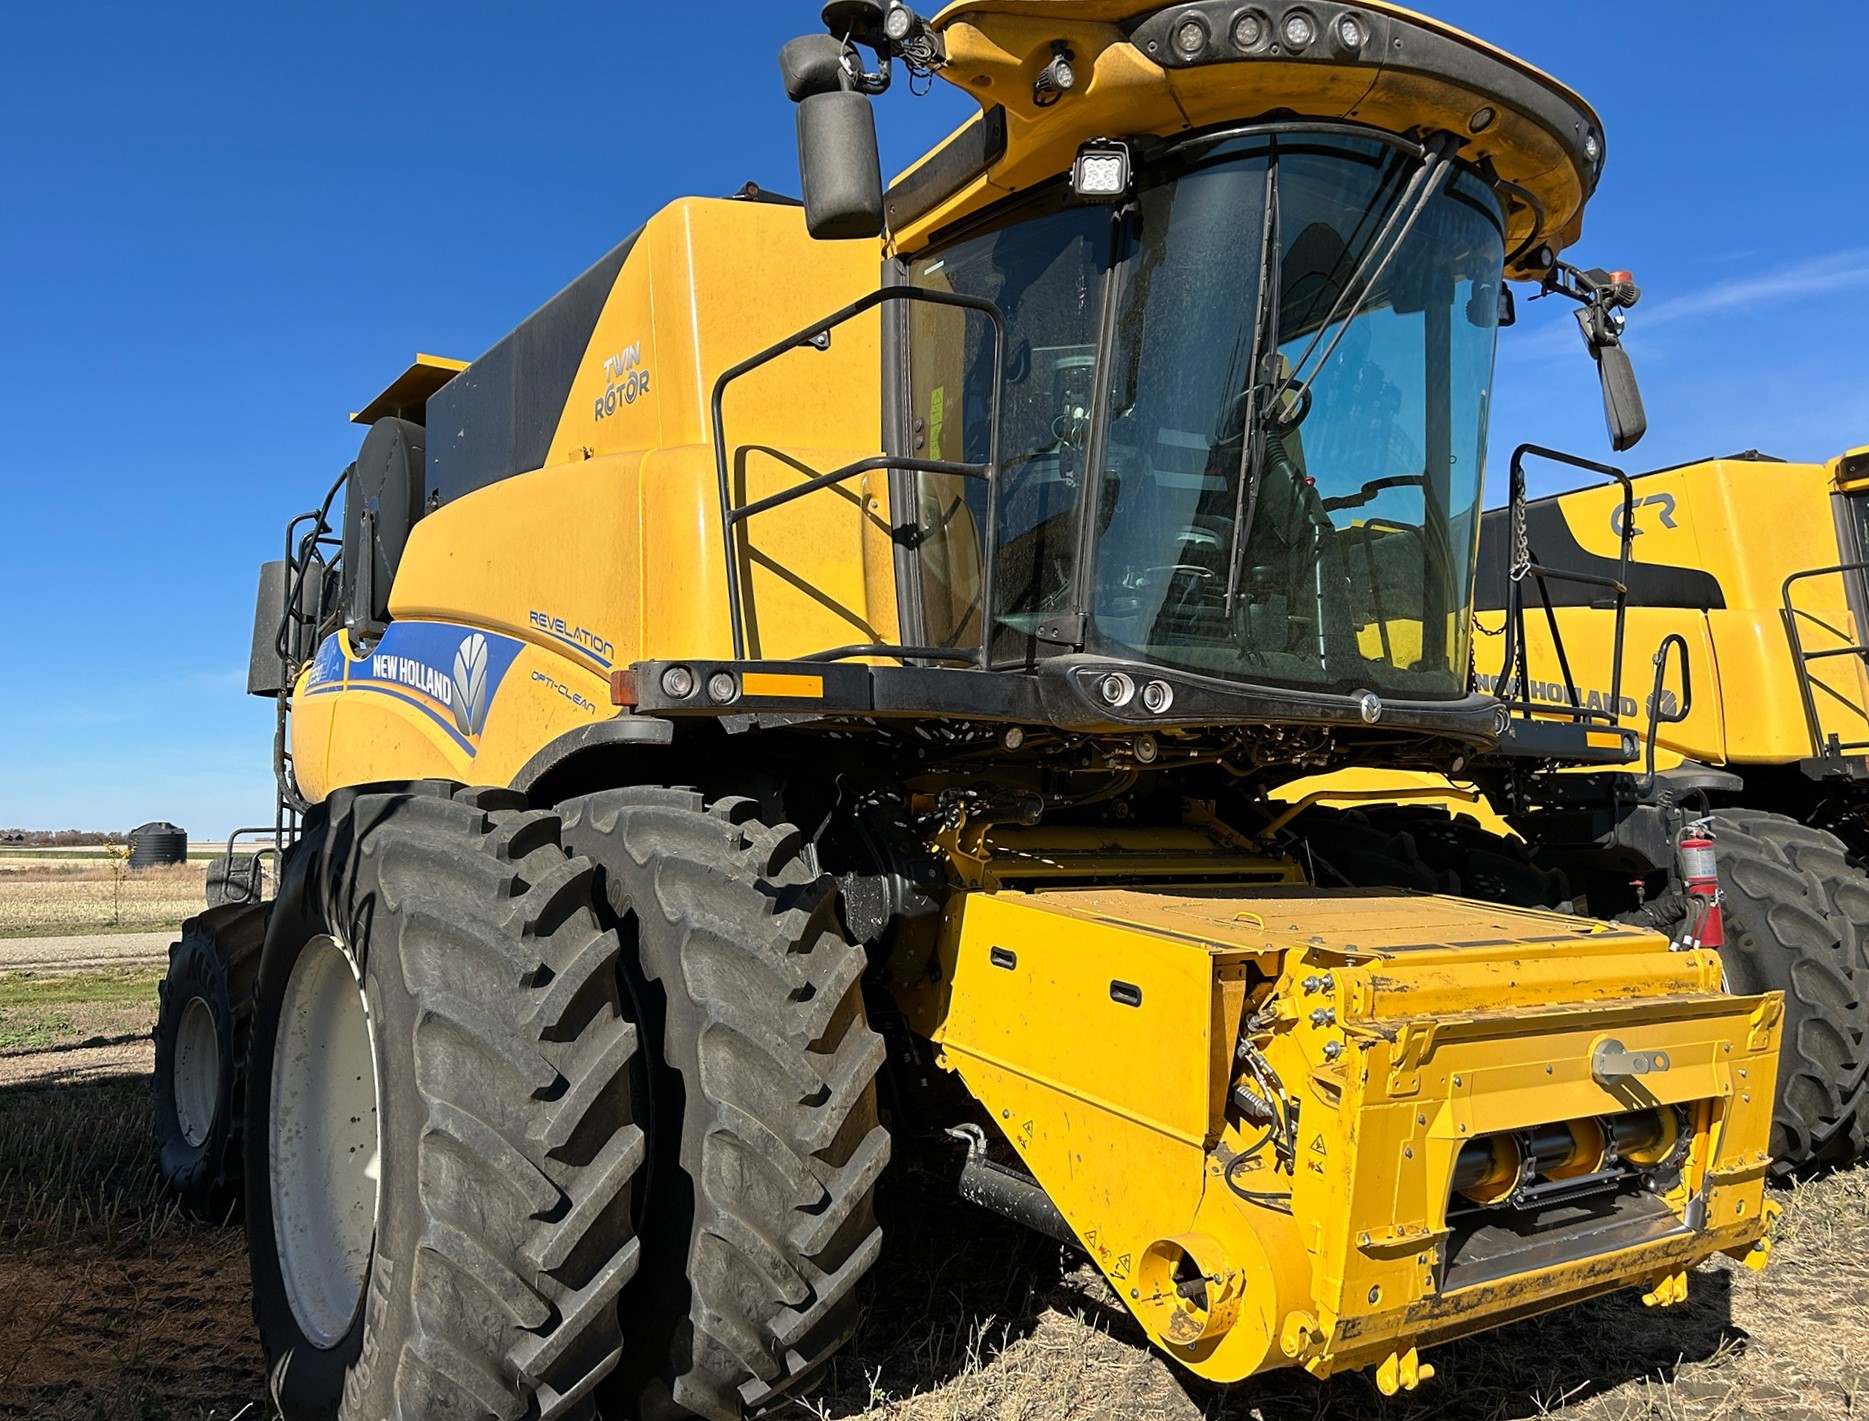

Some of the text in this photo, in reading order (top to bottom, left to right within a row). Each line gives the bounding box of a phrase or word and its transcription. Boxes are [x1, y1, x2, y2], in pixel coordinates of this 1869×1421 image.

[603, 340, 640, 382] TWIN
[595, 369, 650, 422] ROTOR
[1610, 492, 1678, 537] CR
[529, 610, 614, 660] REVELATION
[373, 654, 452, 706] NEW HOLLAND
[531, 670, 596, 715] OPTI-CLEAN
